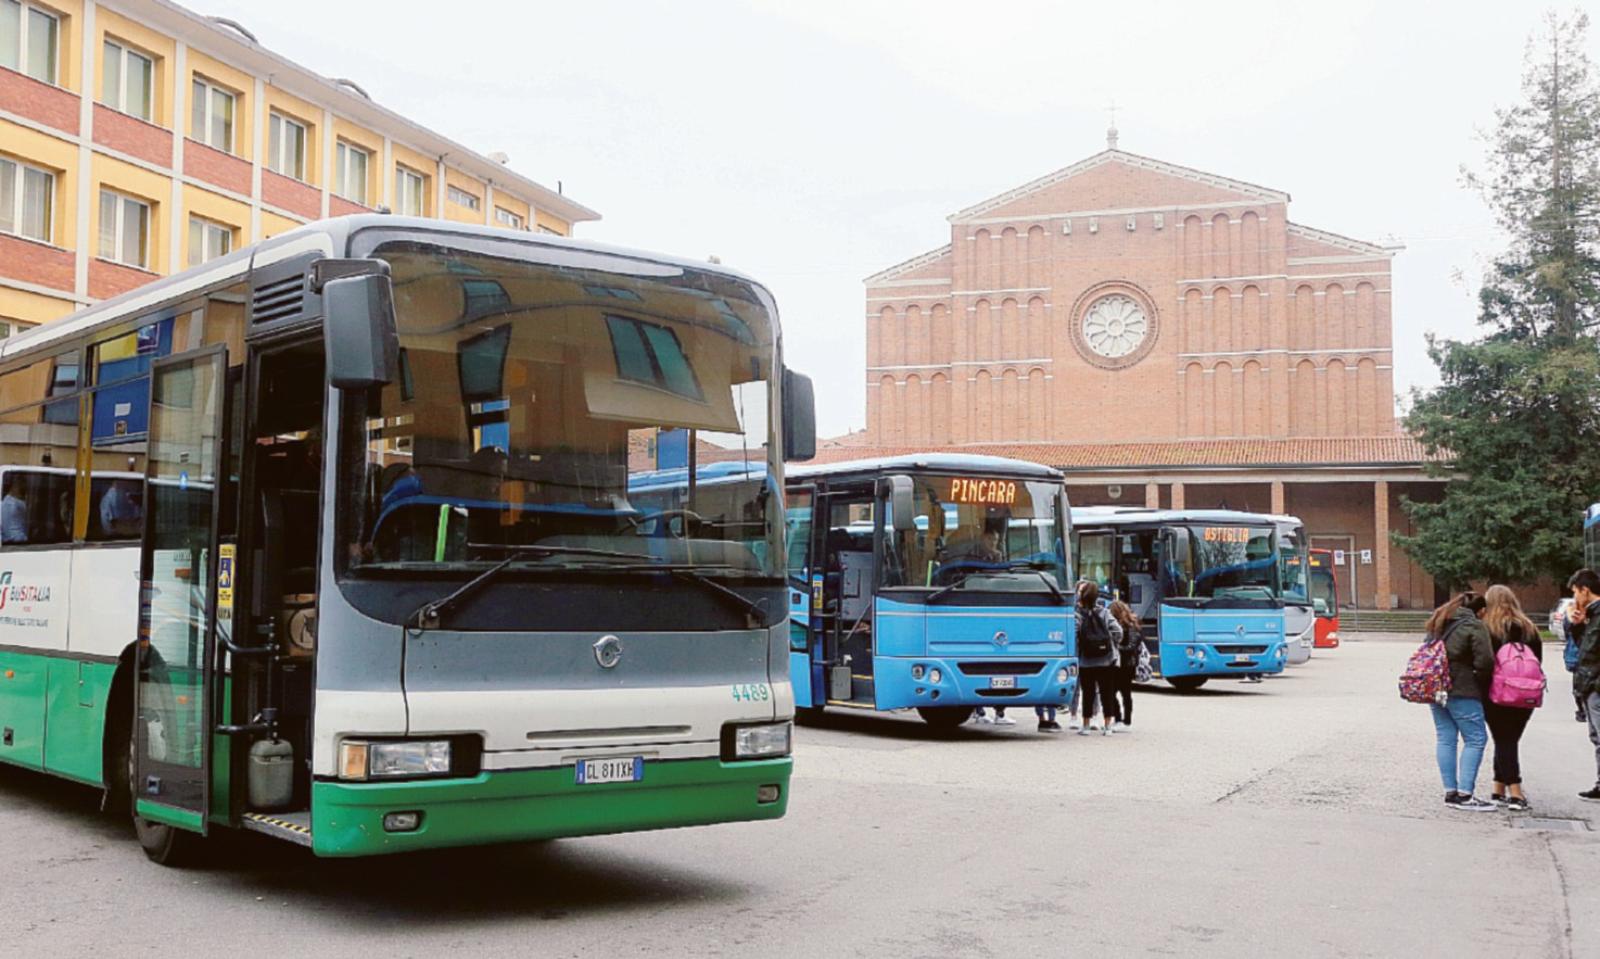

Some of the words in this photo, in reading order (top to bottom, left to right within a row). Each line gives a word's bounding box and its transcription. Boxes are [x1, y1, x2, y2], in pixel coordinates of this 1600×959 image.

[951, 479, 1016, 503] PINCARA
[1204, 527, 1250, 542] OSTIGLIA
[732, 683, 768, 702] 4489
[586, 763, 599, 780] CL
